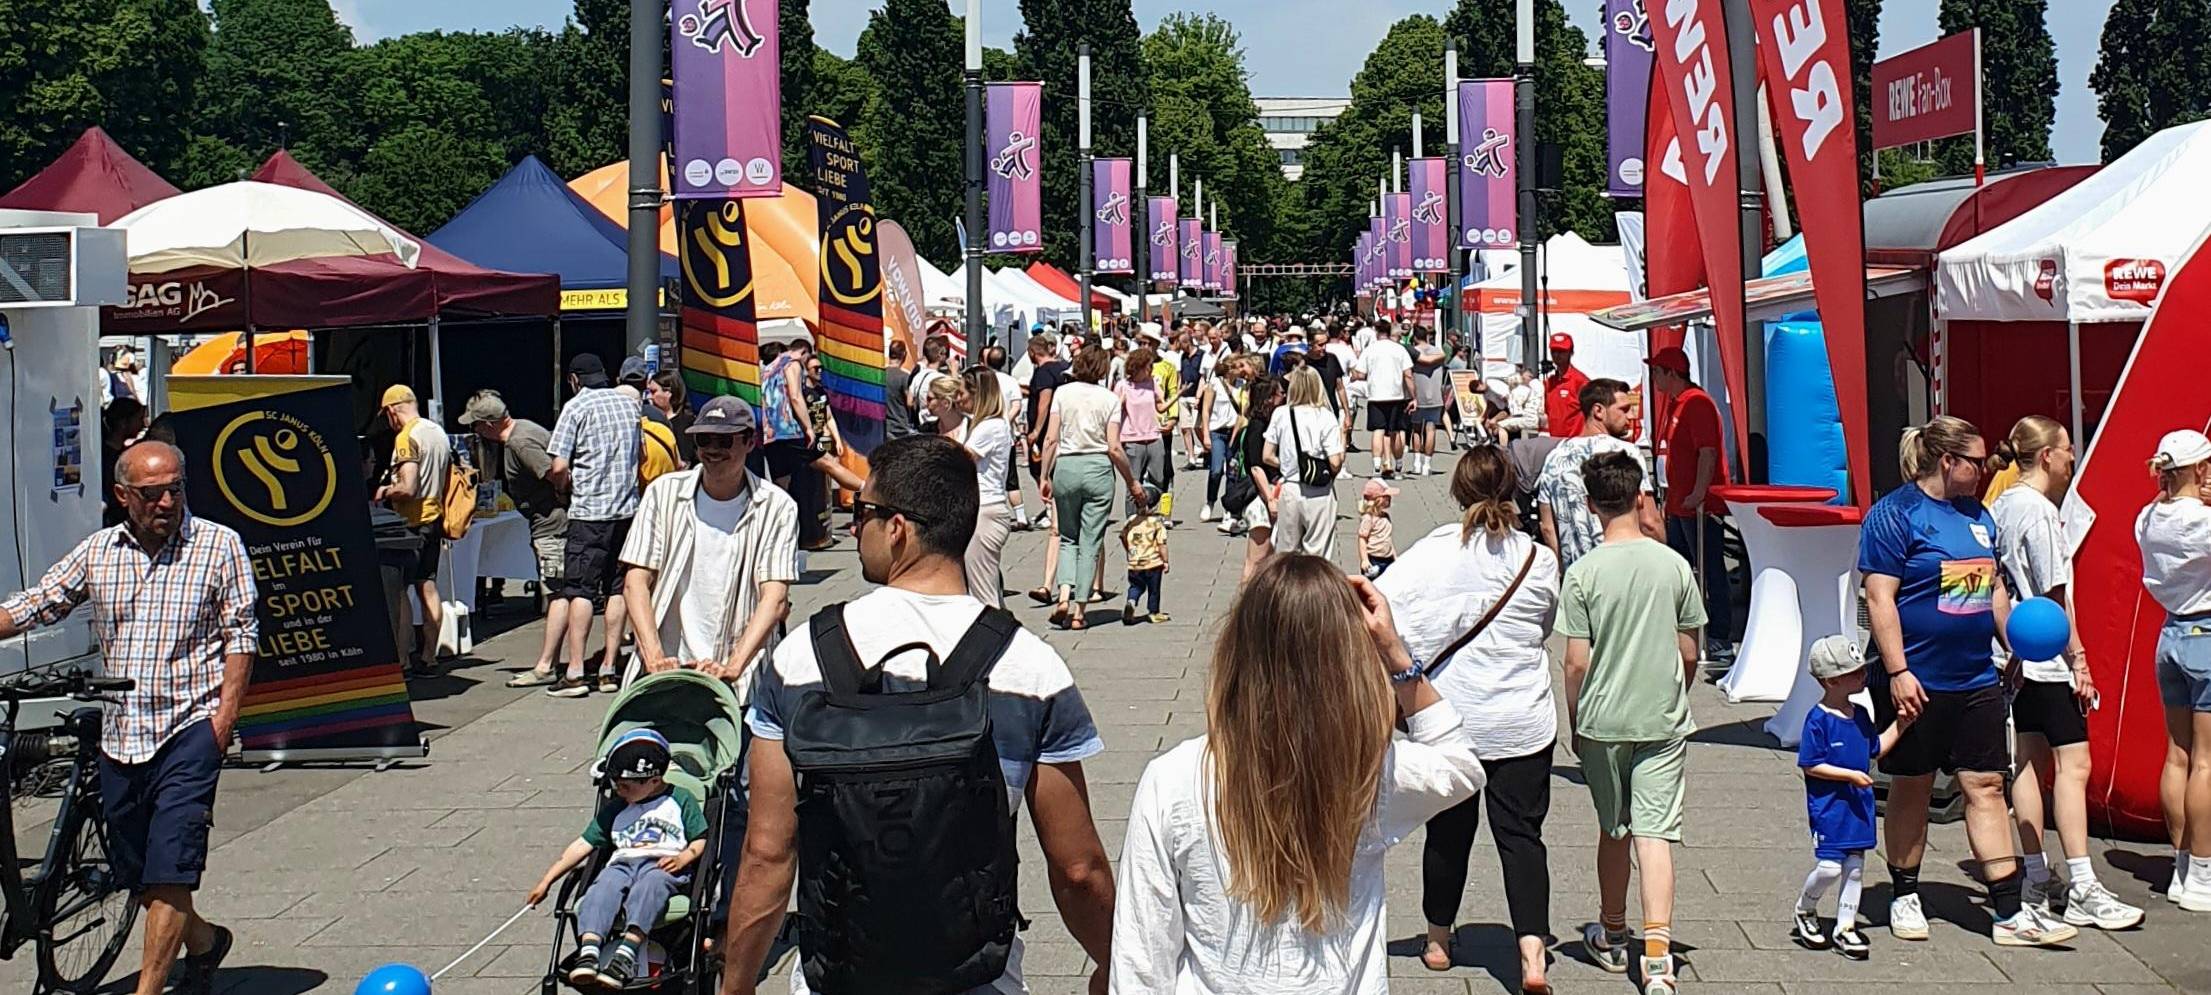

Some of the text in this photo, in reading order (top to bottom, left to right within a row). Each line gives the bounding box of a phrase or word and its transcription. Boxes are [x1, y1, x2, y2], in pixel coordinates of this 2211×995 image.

[1888, 66, 1952, 121] REWE Fan-Box
[813, 129, 855, 154] VIELFALT
[826, 152, 860, 174] SPORT
[817, 166, 848, 188] LIEBE
[2111, 267, 2157, 280] REWE
[2113, 281, 2157, 291] Dein Markt
[599, 292, 620, 306] ALS
[166, 307, 181, 316] AG
[265, 410, 330, 454] SC JANUS KÖLN
[249, 536, 322, 556] Dein Verein für
[271, 581, 287, 591] im
[267, 585, 355, 617] SPORT
[283, 614, 333, 629] und in der
[256, 628, 332, 657] LIEBE
[278, 647, 364, 667] seit 1980 in Köln
